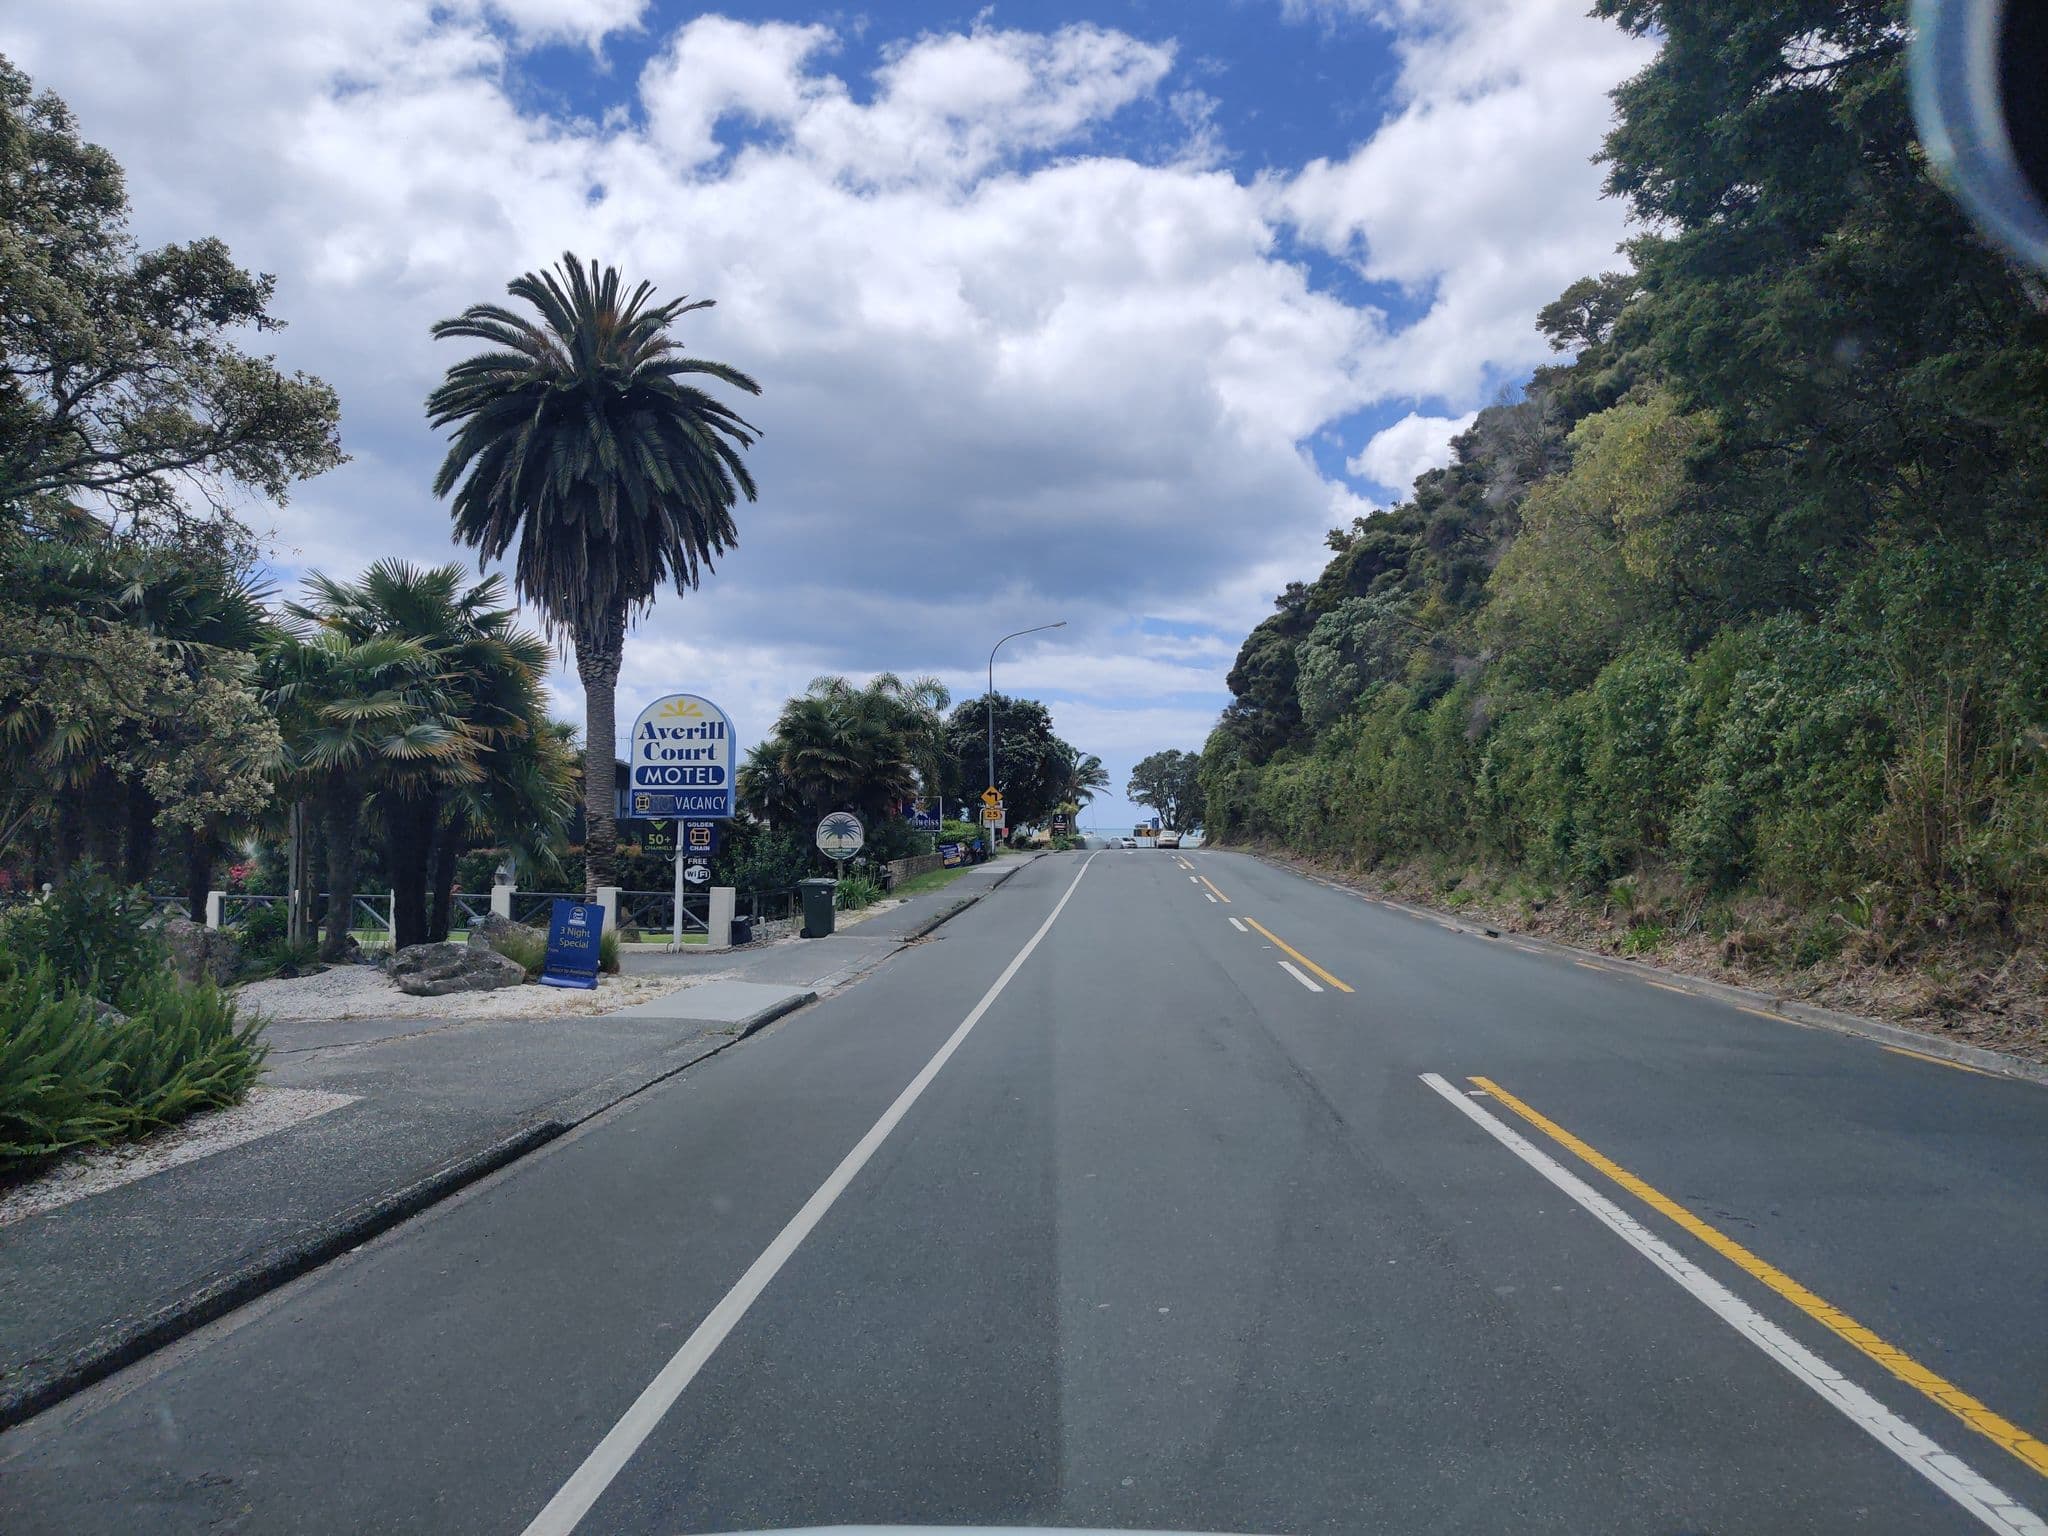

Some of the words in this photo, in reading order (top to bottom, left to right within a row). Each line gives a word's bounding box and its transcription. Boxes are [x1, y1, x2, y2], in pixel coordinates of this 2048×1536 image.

[639, 721, 725, 740] Averill
[644, 742, 716, 760] Court
[644, 767, 718, 784] MOTEL
[675, 796, 726, 810] VACANCY
[648, 833, 671, 845] 50+
[567, 928, 590, 938] Night
[559, 938, 588, 948] Special
